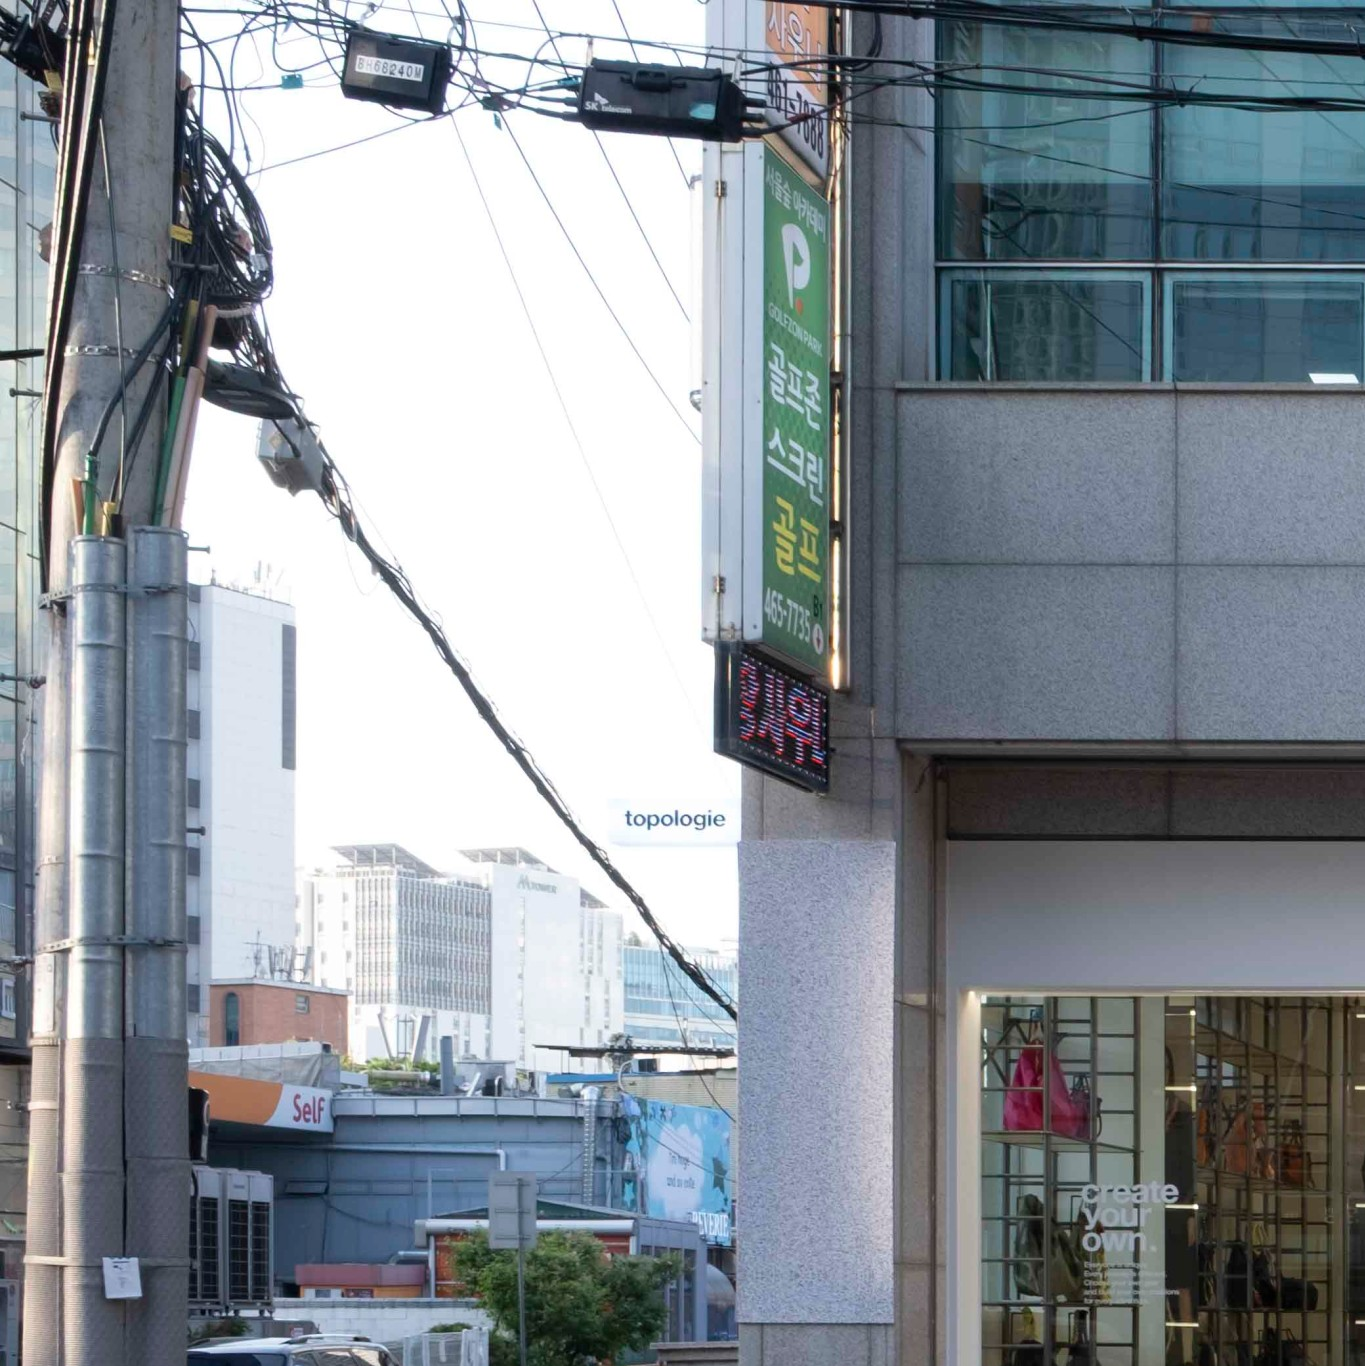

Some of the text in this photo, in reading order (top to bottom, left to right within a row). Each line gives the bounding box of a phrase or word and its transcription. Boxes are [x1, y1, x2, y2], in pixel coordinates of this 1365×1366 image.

[584, 101, 632, 114] SK telecom
[792, 192, 826, 243] 아카데미
[768, 341, 822, 431] 골프존
[767, 427, 823, 507] 스크린
[772, 495, 821, 584] 골프
[764, 586, 811, 643] 465-7735
[625, 809, 726, 831] topologie
[293, 1093, 326, 1125] Self
[1081, 1181, 1180, 1204] create
[1082, 1207, 1153, 1231] your
[1082, 1232, 1158, 1252] own.
